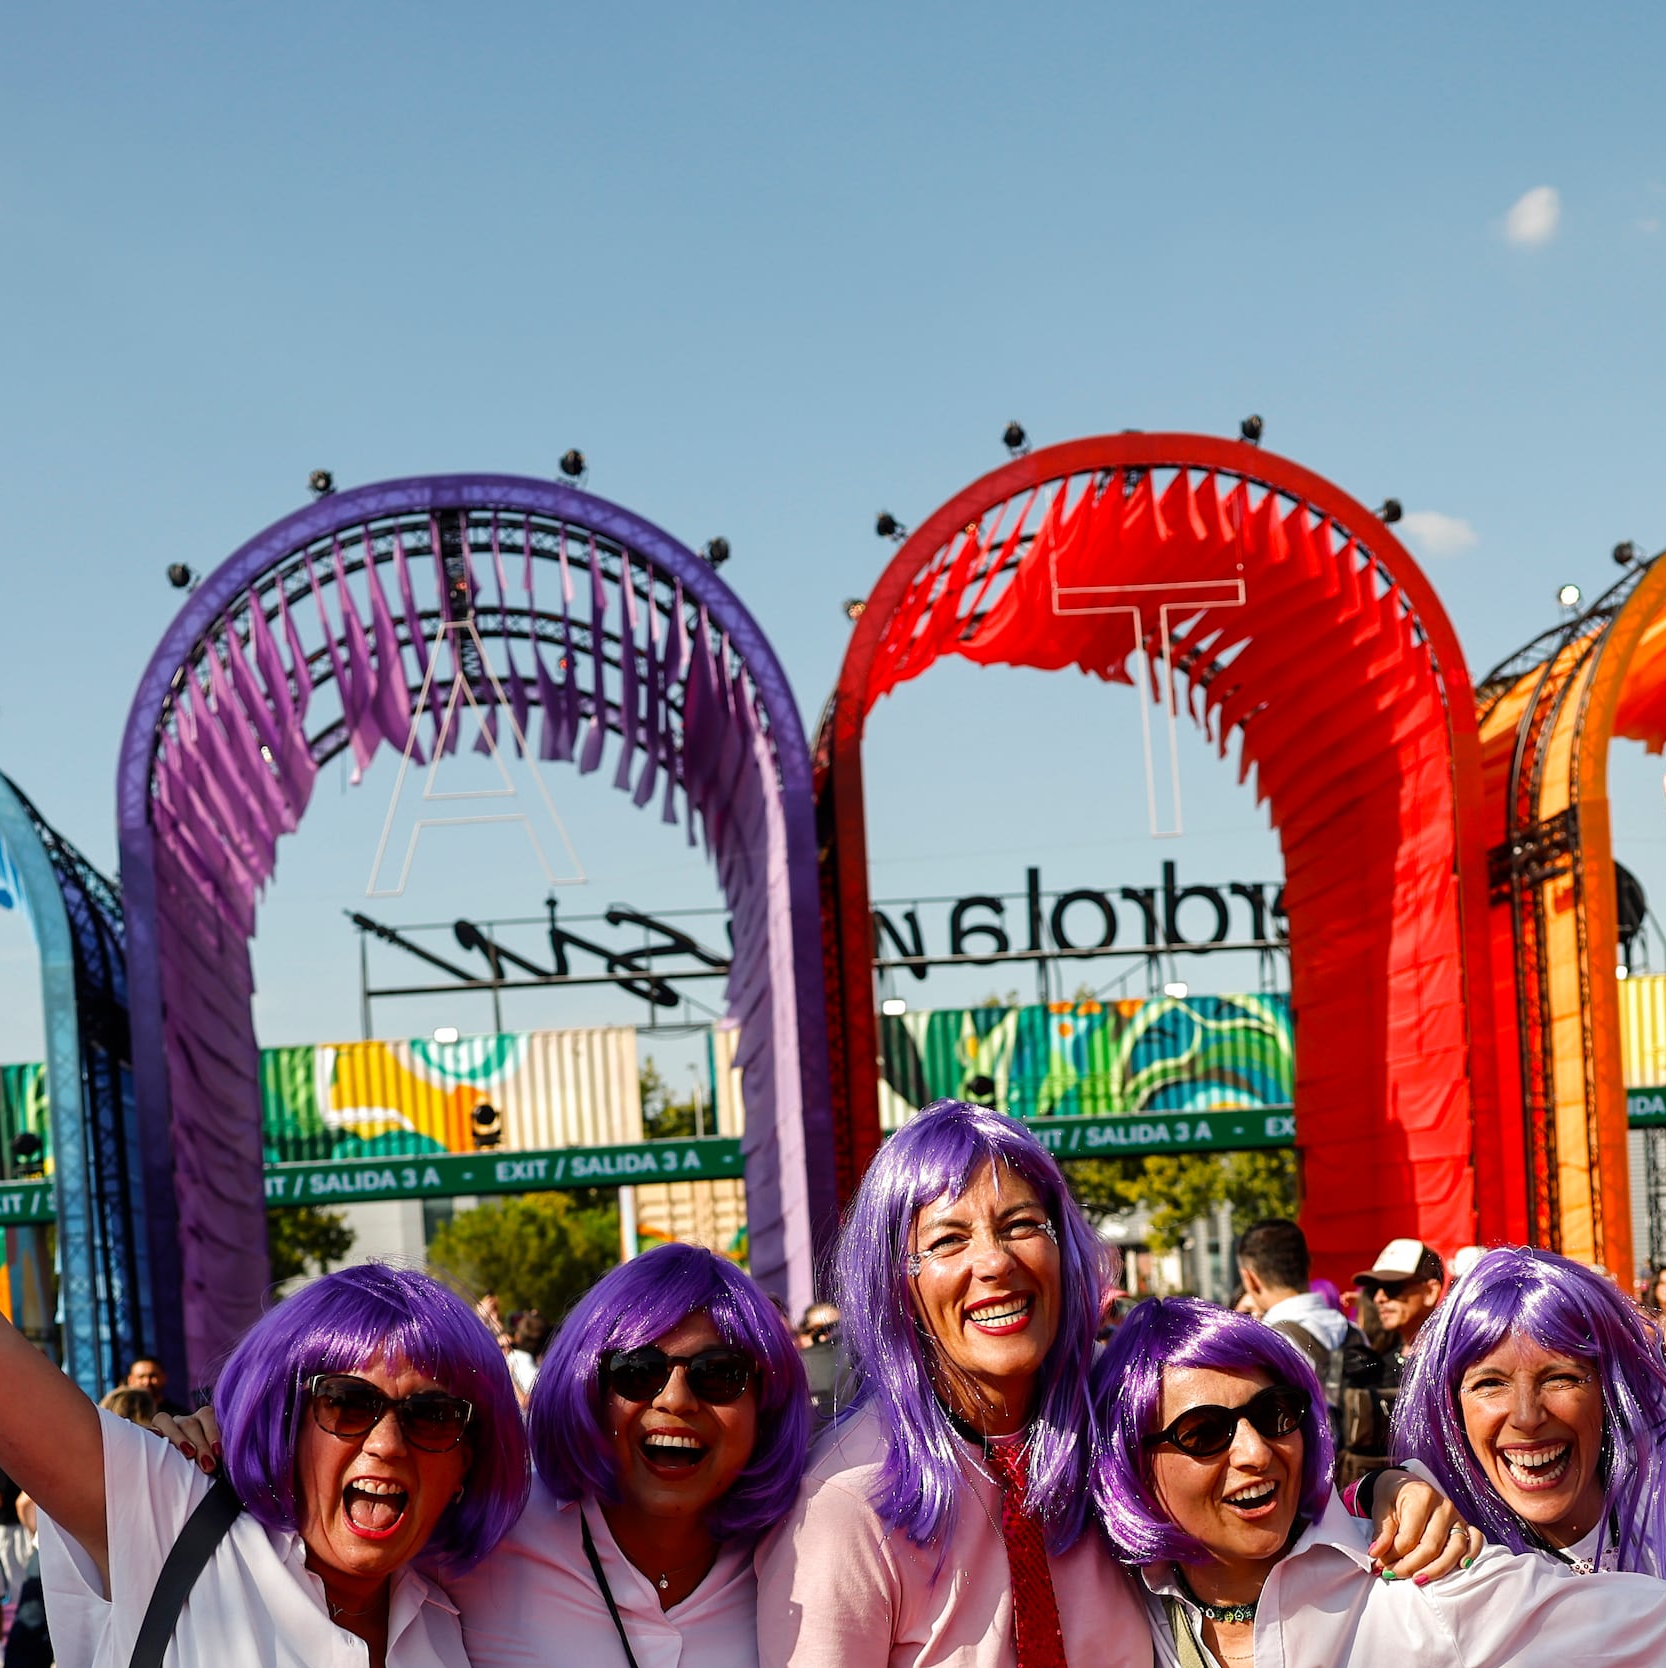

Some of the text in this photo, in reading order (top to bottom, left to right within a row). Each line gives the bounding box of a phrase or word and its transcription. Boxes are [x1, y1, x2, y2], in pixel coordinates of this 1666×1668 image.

[366, 619, 588, 897] A
[1051, 579, 1246, 838] T
[1086, 1124, 1171, 1147] SALIDA
[1175, 1121, 1190, 1142] 3
[1195, 1120, 1212, 1141] A
[1265, 1115, 1296, 1137] EX
[309, 1169, 397, 1195] SALIDA
[401, 1167, 418, 1189] 3
[422, 1165, 441, 1187] A
[495, 1159, 549, 1182] EXIT
[571, 1153, 659, 1178] SALIDA
[663, 1150, 678, 1172] 3
[683, 1149, 702, 1170] A
